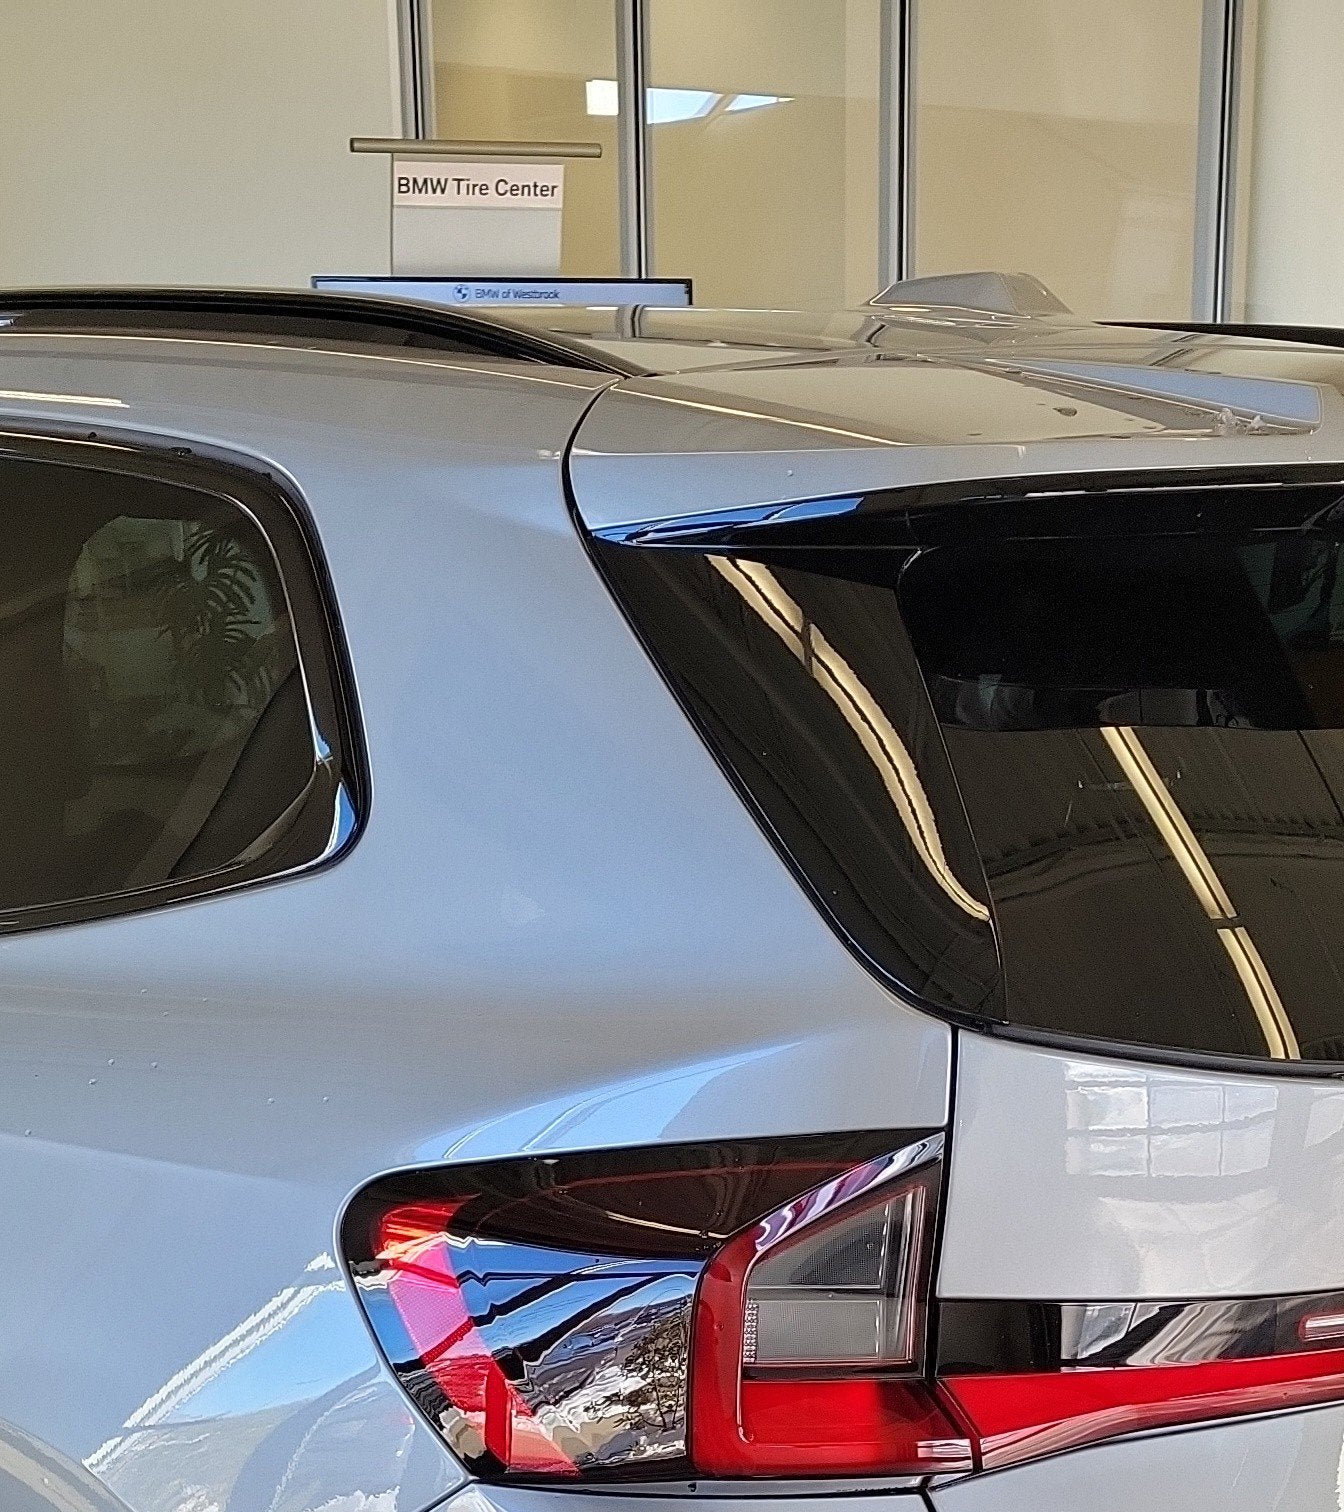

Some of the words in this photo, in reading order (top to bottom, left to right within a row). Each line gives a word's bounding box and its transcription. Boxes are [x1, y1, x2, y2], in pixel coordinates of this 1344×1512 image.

[397, 176, 448, 195] BMW
[452, 177, 490, 196] Tire
[495, 178, 558, 198] Center
[474, 288, 500, 299] BMW
[501, 289, 511, 299] of
[513, 288, 560, 300] Westbrook
